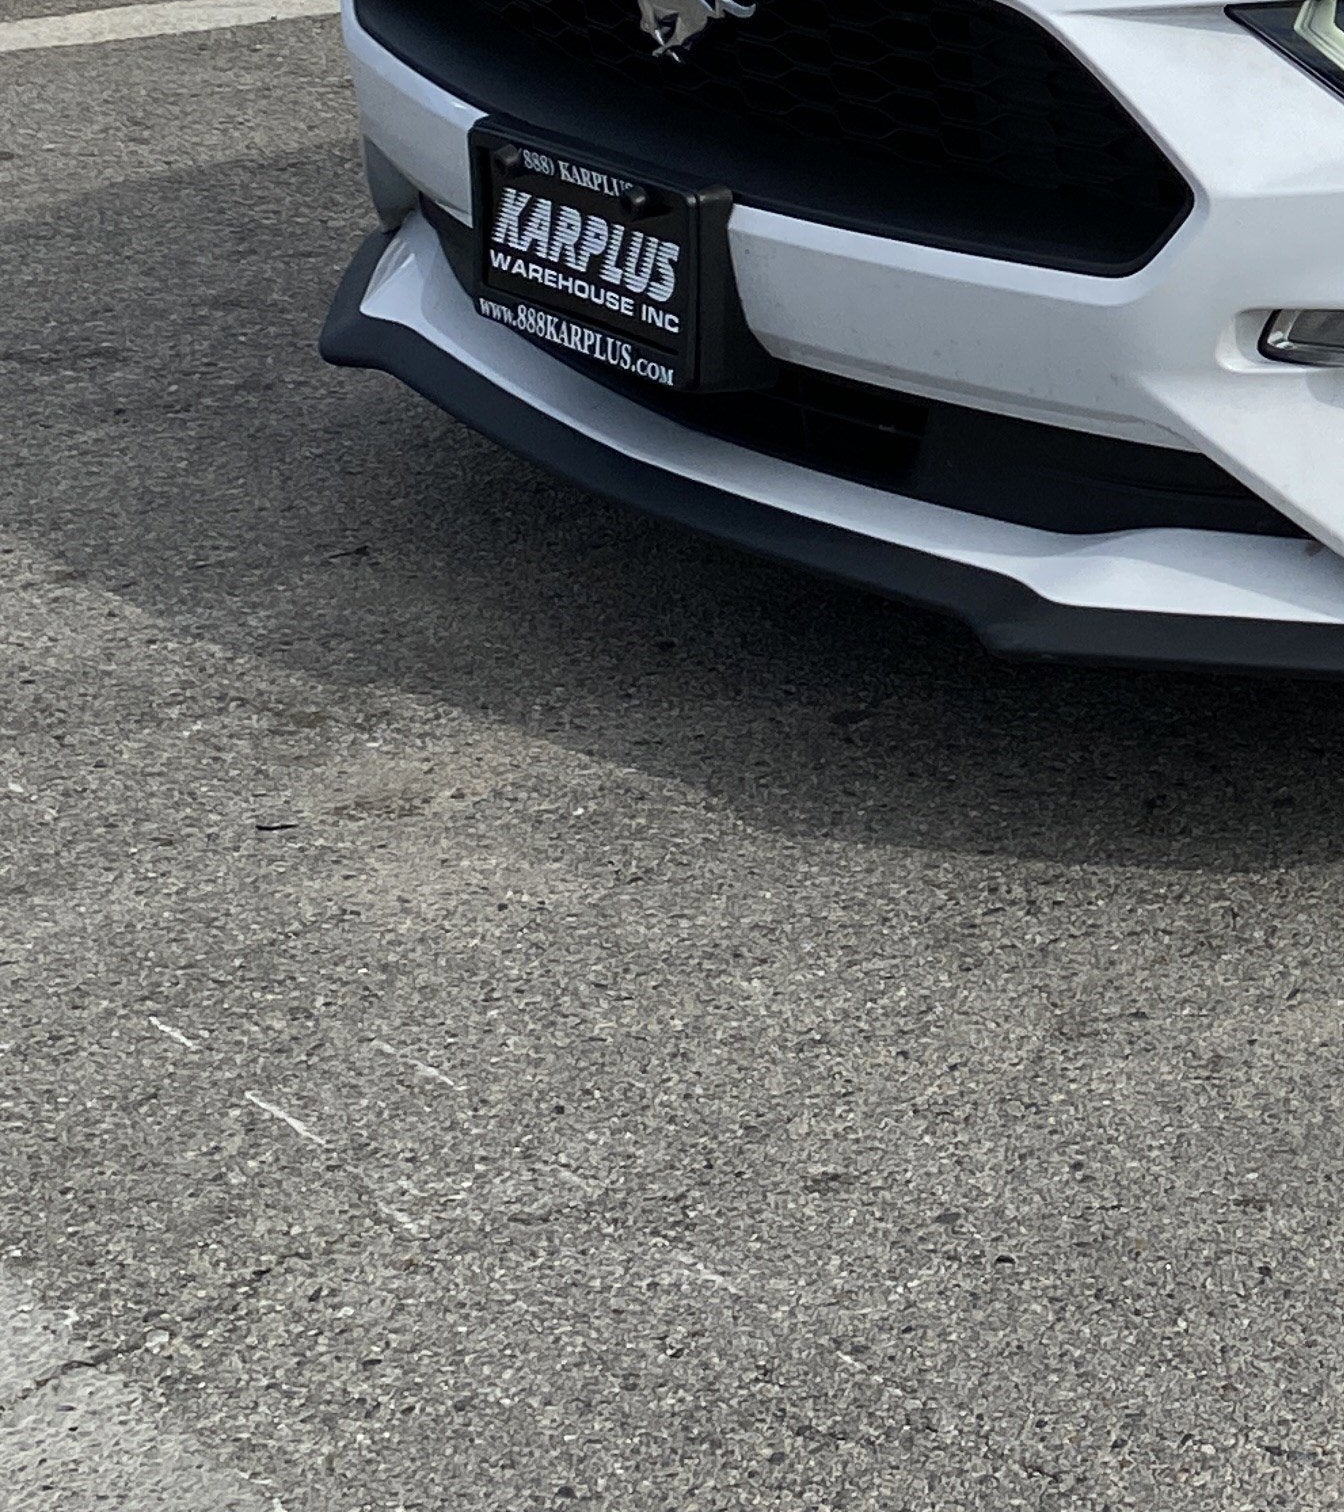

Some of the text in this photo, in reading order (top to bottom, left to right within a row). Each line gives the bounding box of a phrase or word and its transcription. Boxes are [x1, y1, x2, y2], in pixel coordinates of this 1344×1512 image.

[489, 249, 680, 334] WAREHOUSE INC
[491, 187, 680, 303] KARPLUS
